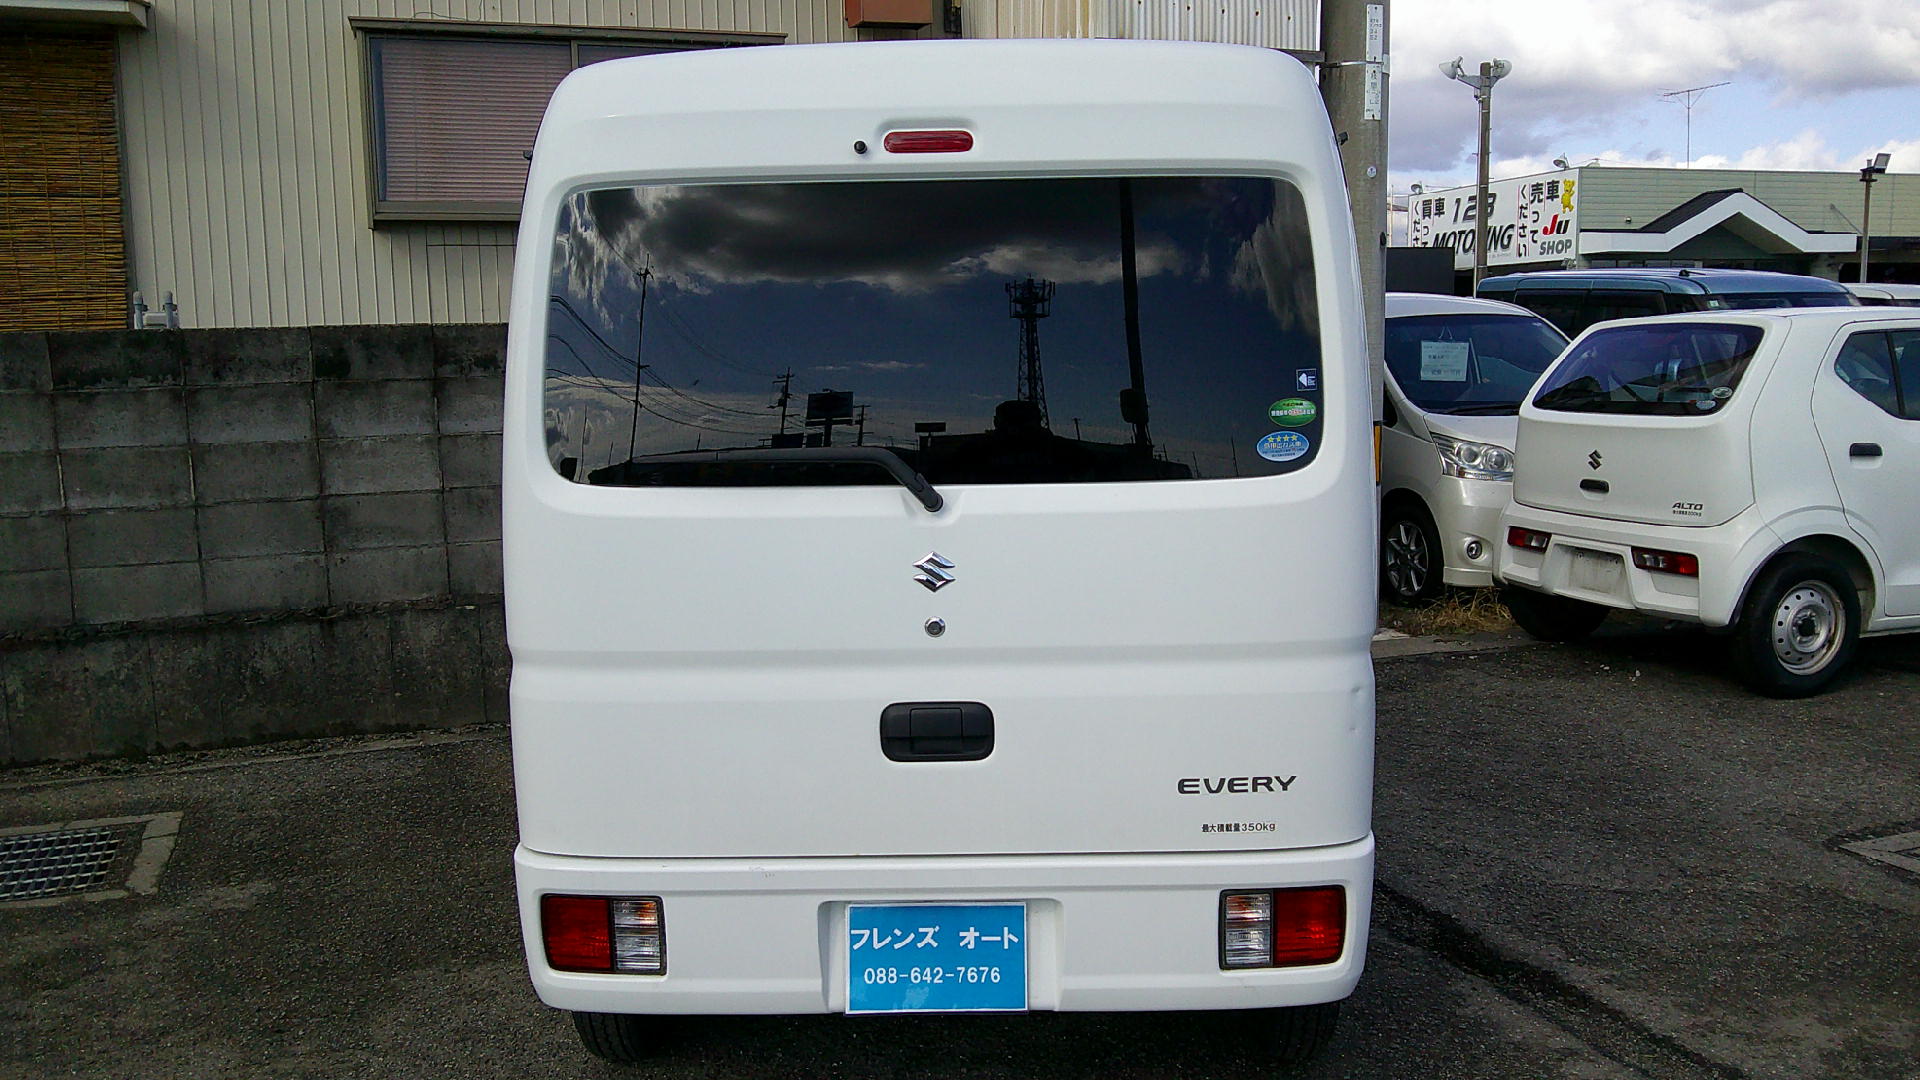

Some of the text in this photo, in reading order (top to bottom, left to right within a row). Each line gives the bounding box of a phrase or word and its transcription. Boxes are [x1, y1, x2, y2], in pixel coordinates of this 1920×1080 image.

[1546, 180, 1560, 202] 車
[1434, 197, 1446, 218] 車
[1412, 201, 1421, 247] くださ
[1518, 184, 1529, 258] ください
[1432, 223, 1516, 255] MOTONG
[1539, 239, 1572, 256] SHOP
[1672, 502, 1703, 510] ALTO
[1177, 775, 1297, 794] EVERY
[850, 925, 1019, 951] フレンズ オート
[864, 966, 1001, 985] 088-642-7676
